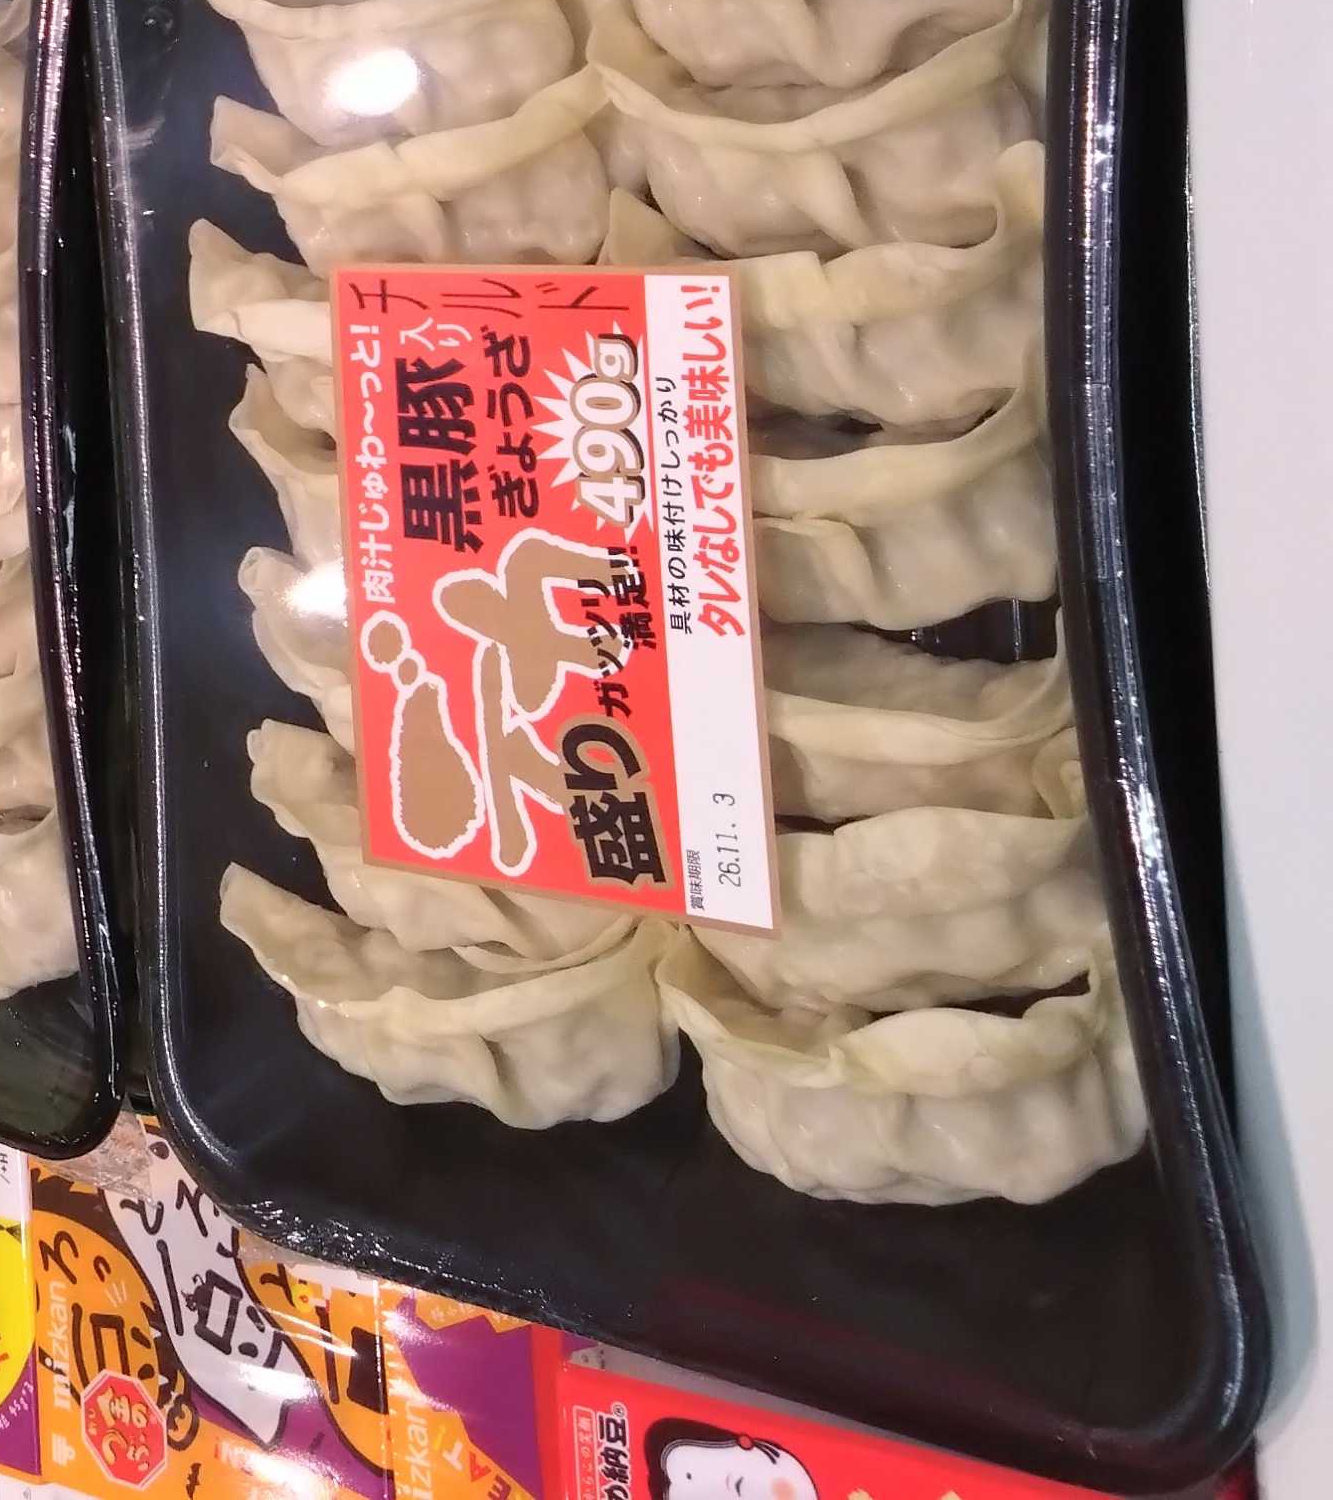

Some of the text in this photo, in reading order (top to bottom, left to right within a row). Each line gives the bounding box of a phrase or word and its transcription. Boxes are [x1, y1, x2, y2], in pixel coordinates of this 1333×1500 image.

[347, 277, 631, 320] チルド
[393, 316, 483, 553] 黒豚 入り
[481, 323, 541, 521] ぎょうざ
[571, 331, 647, 527] 490g
[655, 373, 694, 635] 具材の味付けしっかり
[681, 282, 748, 638] タレなしでも美味しい!
[559, 721, 667, 885] 盛り
[43, 1278, 73, 1412] mizkan
